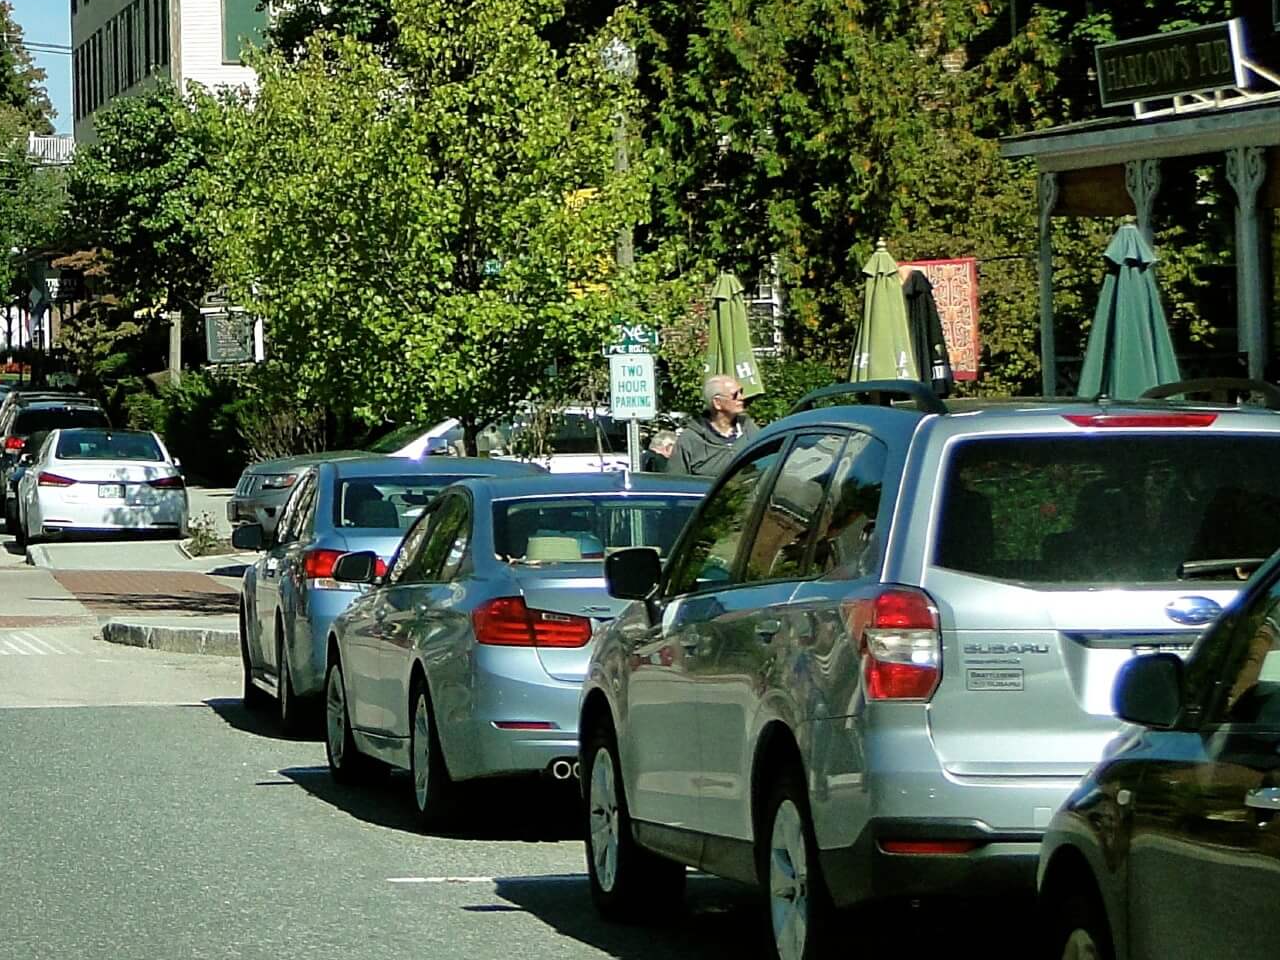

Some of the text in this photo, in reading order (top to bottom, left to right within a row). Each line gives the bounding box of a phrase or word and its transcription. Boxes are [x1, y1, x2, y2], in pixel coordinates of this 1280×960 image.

[1103, 39, 1232, 91] HARLOW'S PUB
[621, 365, 643, 377] TWO
[617, 380, 647, 393] HOUR
[615, 396, 651, 408] PARKING
[964, 644, 1050, 655] SUBARU
